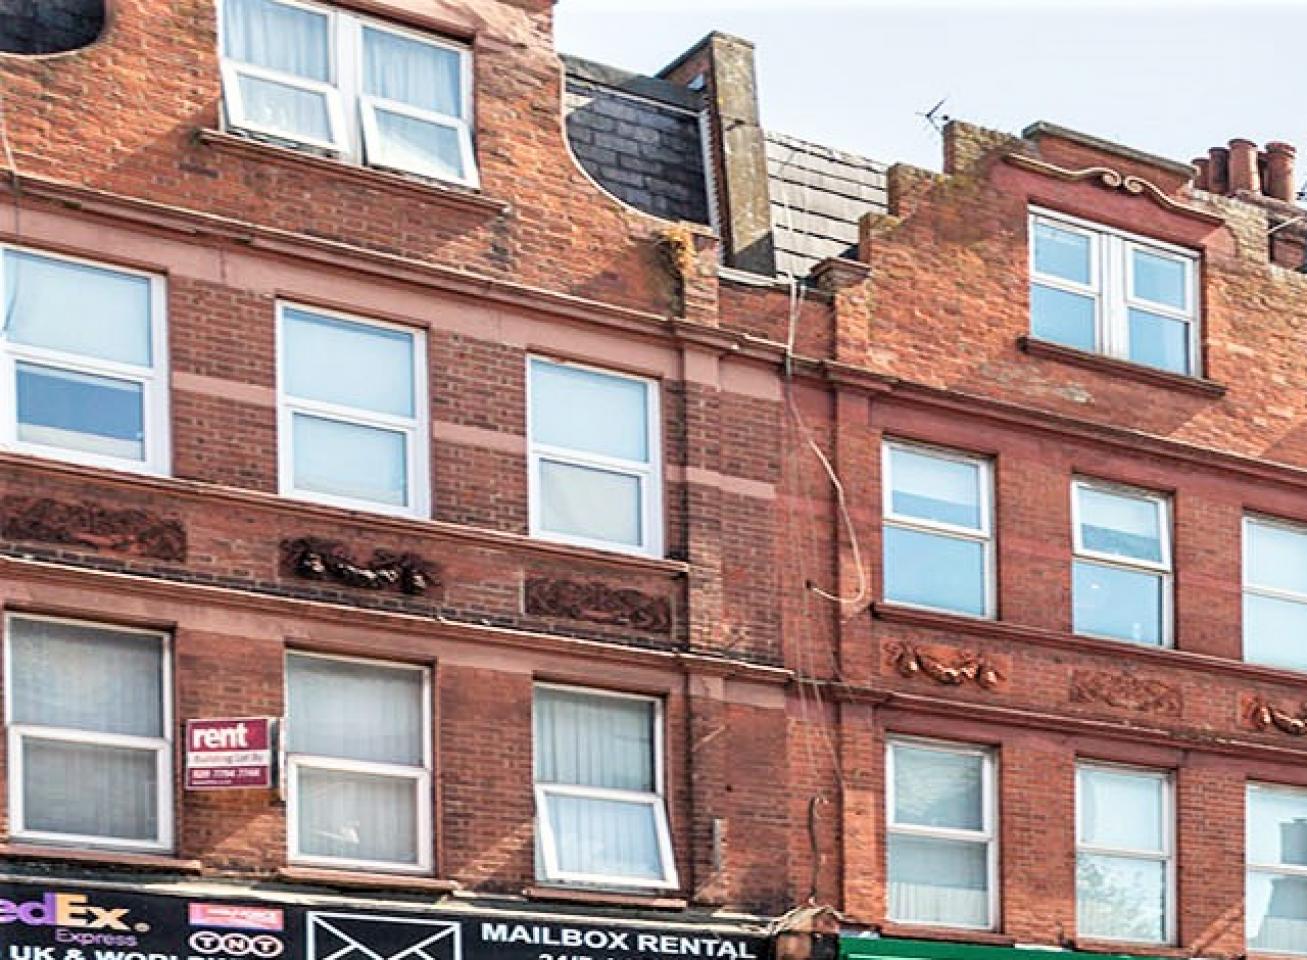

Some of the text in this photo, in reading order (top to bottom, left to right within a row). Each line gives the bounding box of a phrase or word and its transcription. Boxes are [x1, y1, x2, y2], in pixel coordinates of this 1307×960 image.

[191, 722, 248, 749] rent
[0, 892, 130, 931] edEx
[55, 928, 138, 947] Express
[189, 931, 284, 957] TNT
[481, 922, 757, 960] MAILBOX RENTAL
